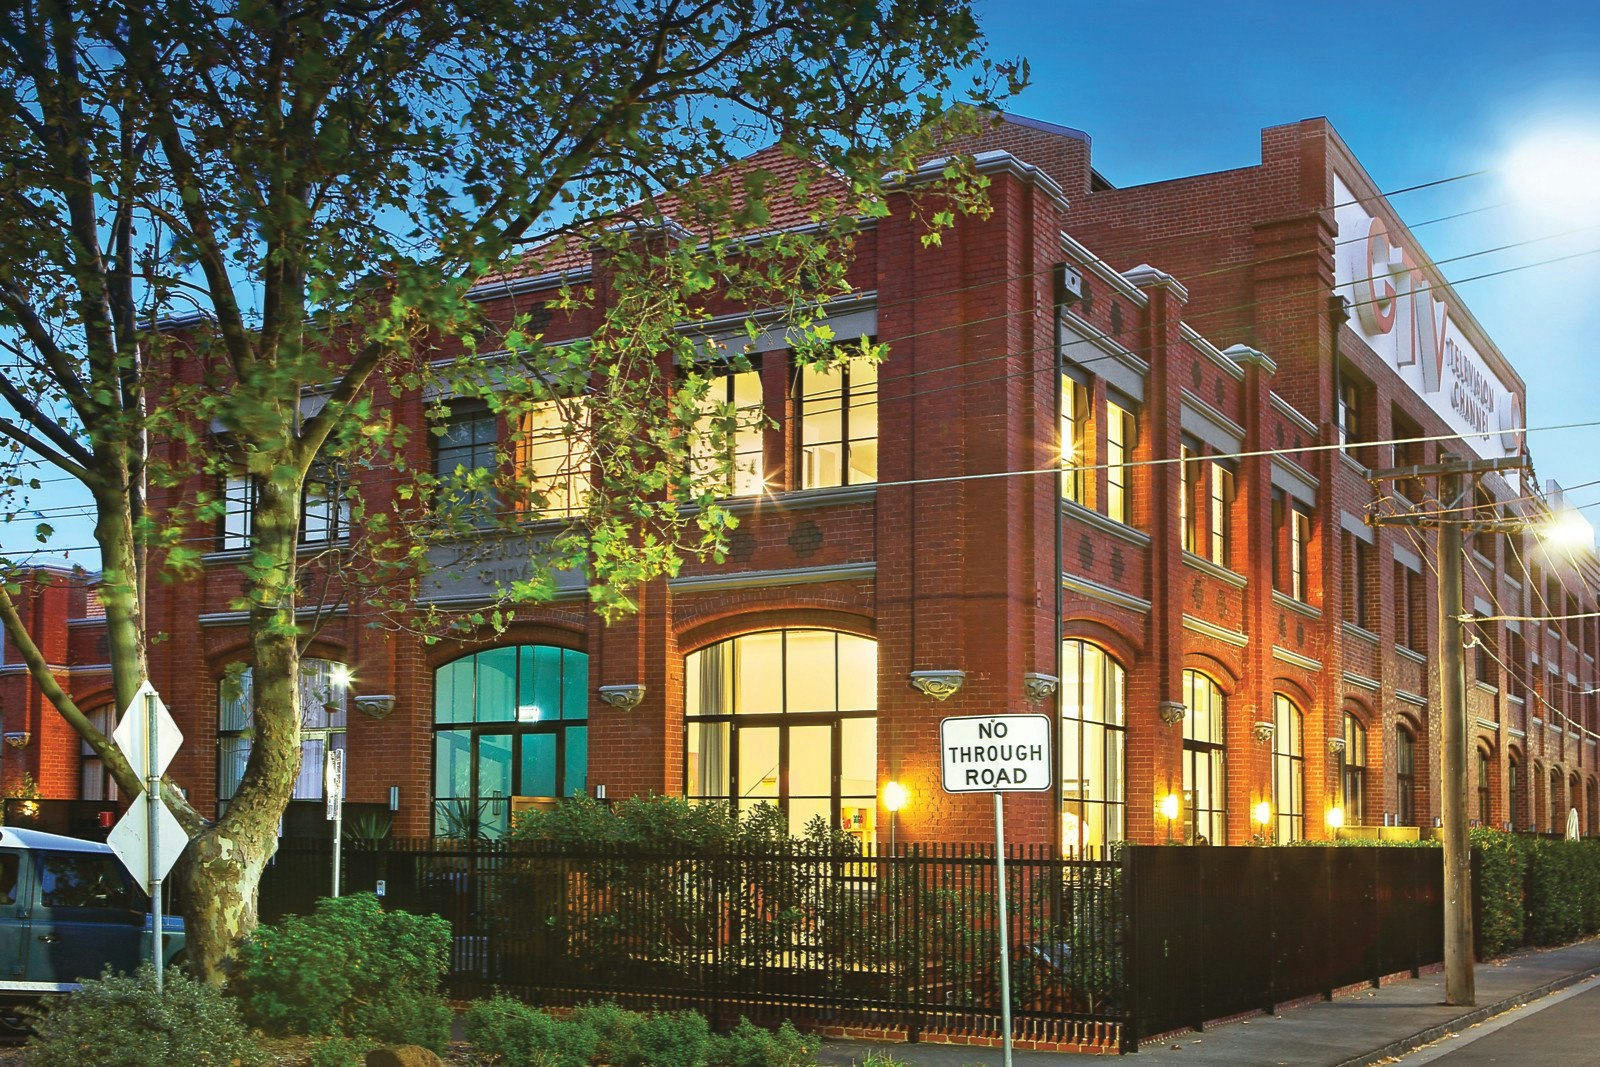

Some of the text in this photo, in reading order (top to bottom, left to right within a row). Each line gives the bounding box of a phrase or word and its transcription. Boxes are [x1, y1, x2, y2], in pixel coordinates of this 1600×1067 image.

[1353, 216, 1448, 392] GTV
[1446, 337, 1494, 413] TELEVISION
[1451, 381, 1490, 441] CHANNEL
[978, 722, 1008, 739] NO
[948, 744, 1042, 763] THROUGH
[965, 768, 1027, 785] ROAD
